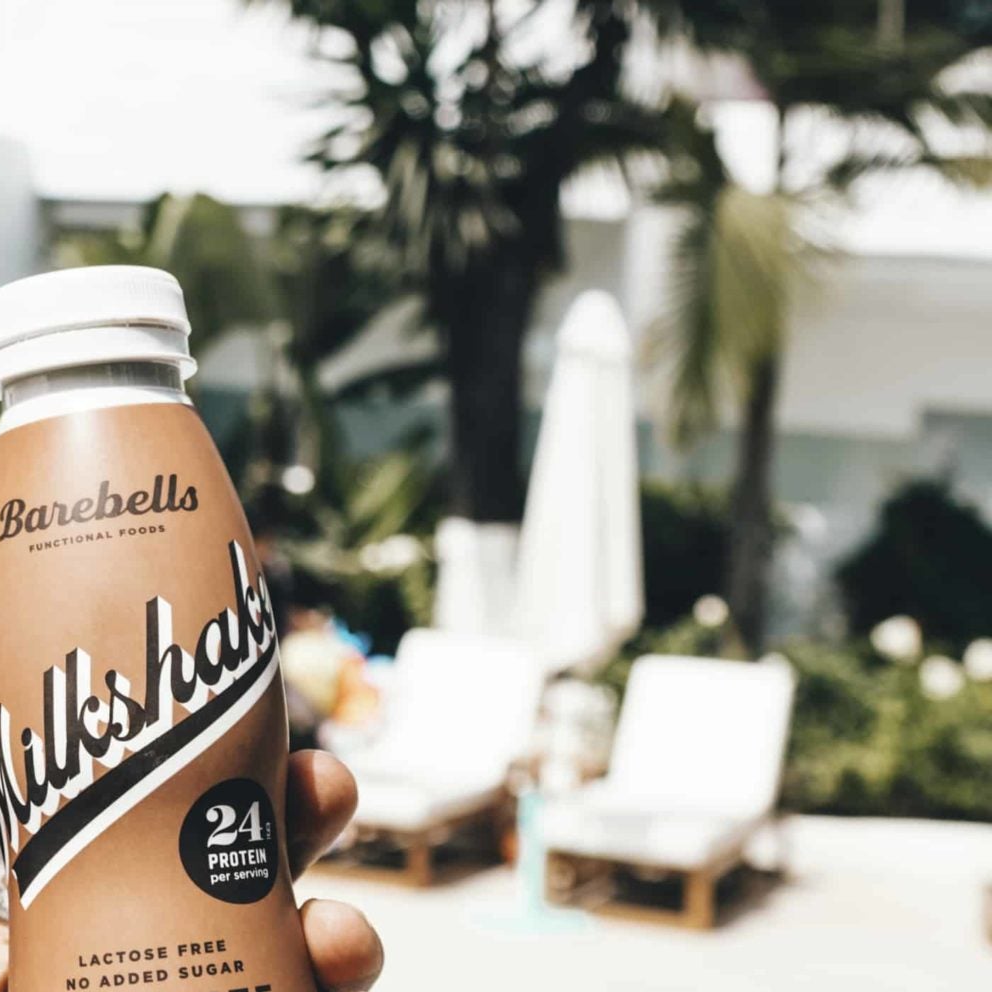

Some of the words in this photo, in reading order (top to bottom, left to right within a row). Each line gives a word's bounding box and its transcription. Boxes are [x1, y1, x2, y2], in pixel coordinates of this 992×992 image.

[29, 531, 113, 553] FUNCTIONAL
[119, 524, 166, 537] FOODS
[205, 801, 264, 848] 24
[208, 848, 267, 870] PROTEIN
[210, 871, 231, 885] per
[233, 867, 269, 881] serving
[79, 947, 168, 967] LACTOSE
[178, 940, 227, 957] FREE
[66, 978, 90, 991] NO
[99, 969, 168, 988] ADDED
[179, 960, 244, 979] SUGAR
